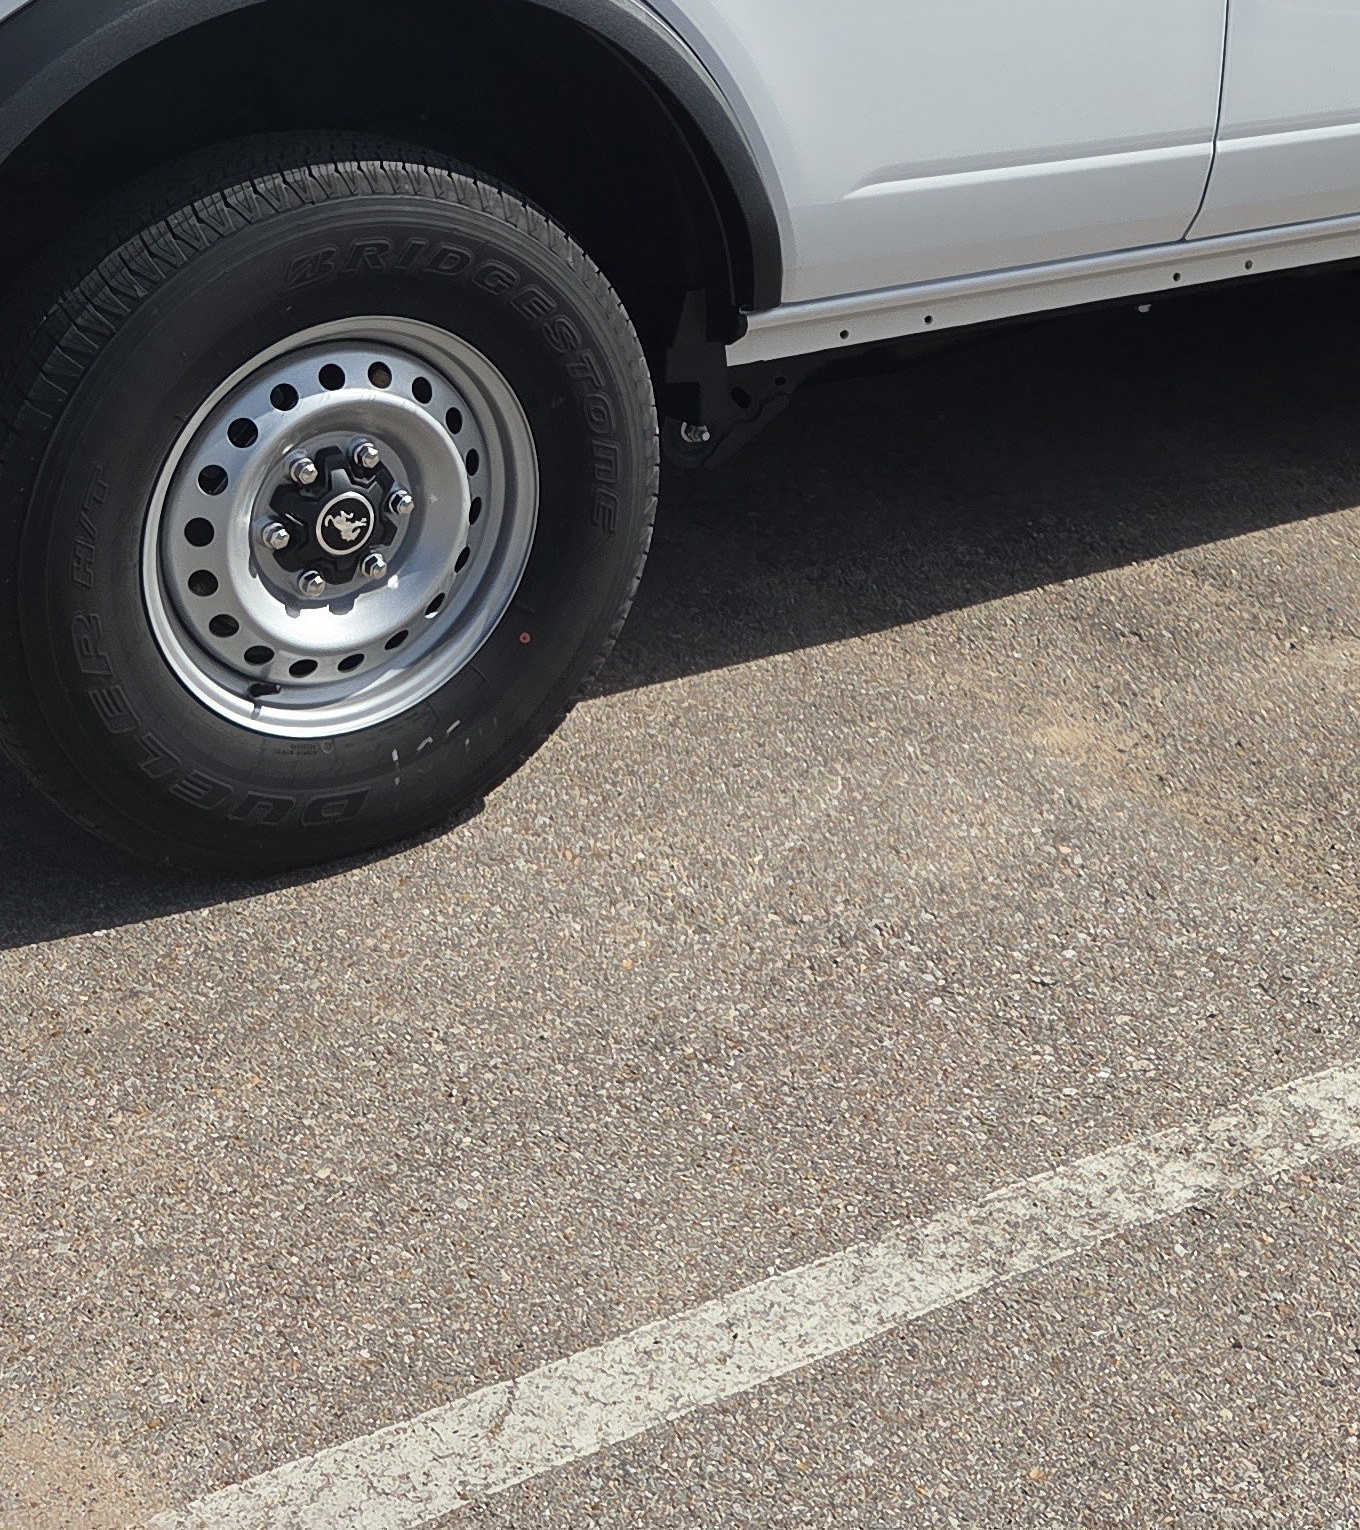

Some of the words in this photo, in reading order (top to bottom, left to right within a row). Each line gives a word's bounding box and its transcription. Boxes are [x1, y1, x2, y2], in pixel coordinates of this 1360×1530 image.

[282, 236, 622, 537] BRIDGESTONE
[69, 461, 112, 590] H/T
[70, 610, 373, 828] DUELER
